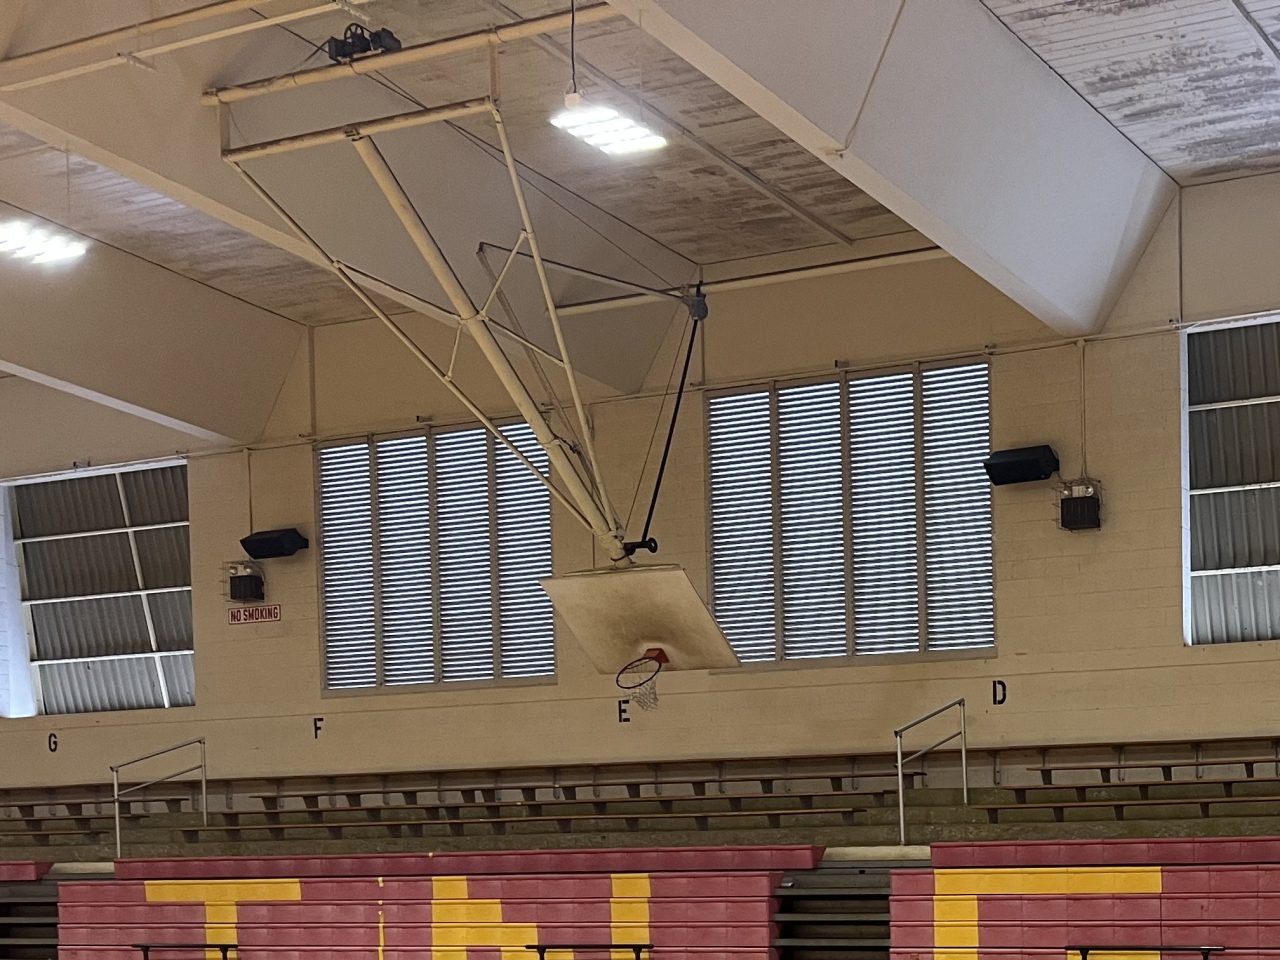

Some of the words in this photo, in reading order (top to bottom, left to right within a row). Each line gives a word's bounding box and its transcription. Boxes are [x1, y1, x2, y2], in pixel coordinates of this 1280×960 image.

[230, 610, 242, 622] NO
[243, 606, 279, 621] SMOKING
[992, 680, 1007, 705] D
[618, 700, 630, 723] E
[313, 717, 324, 739] F
[48, 732, 58, 752] G
